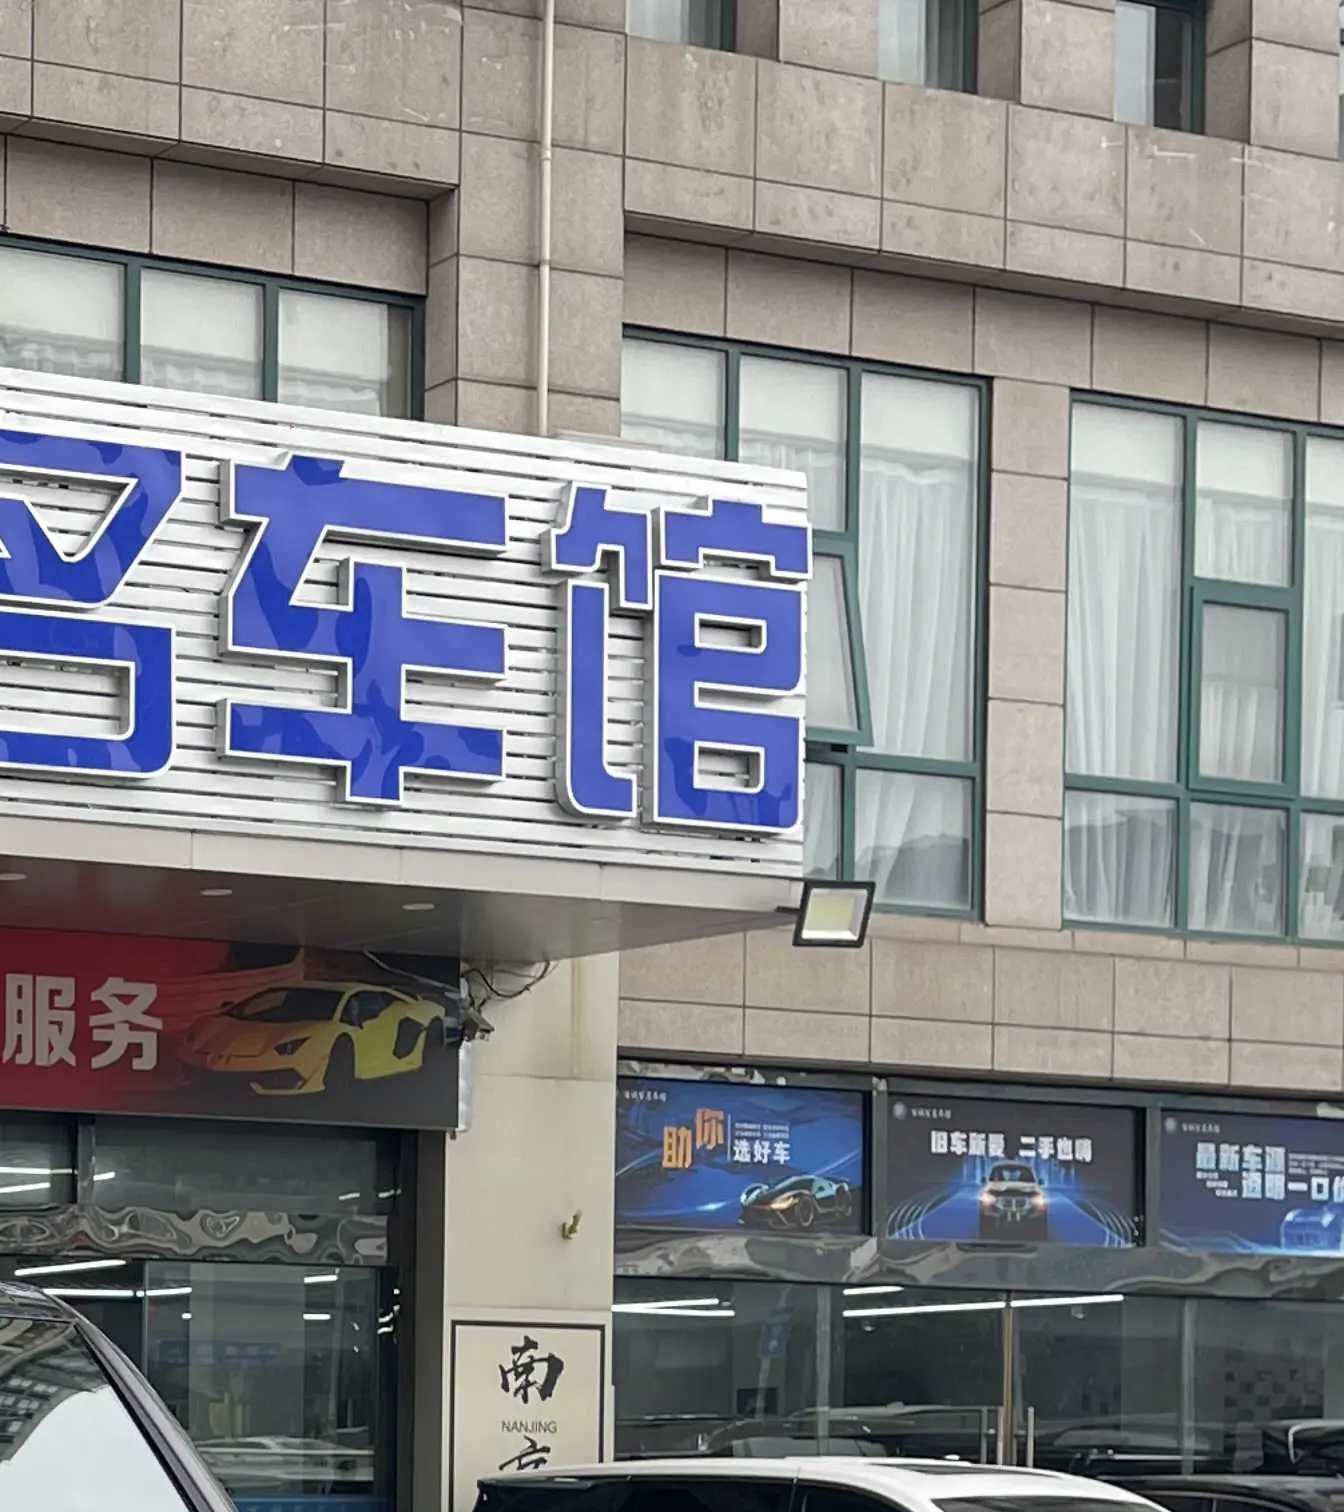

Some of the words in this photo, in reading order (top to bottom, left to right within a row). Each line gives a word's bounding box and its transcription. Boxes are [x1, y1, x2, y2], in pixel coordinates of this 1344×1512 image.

[733, 1138, 791, 1165] 选好车
[498, 1335, 565, 1405] 南
[501, 1420, 558, 1434] NANJING
